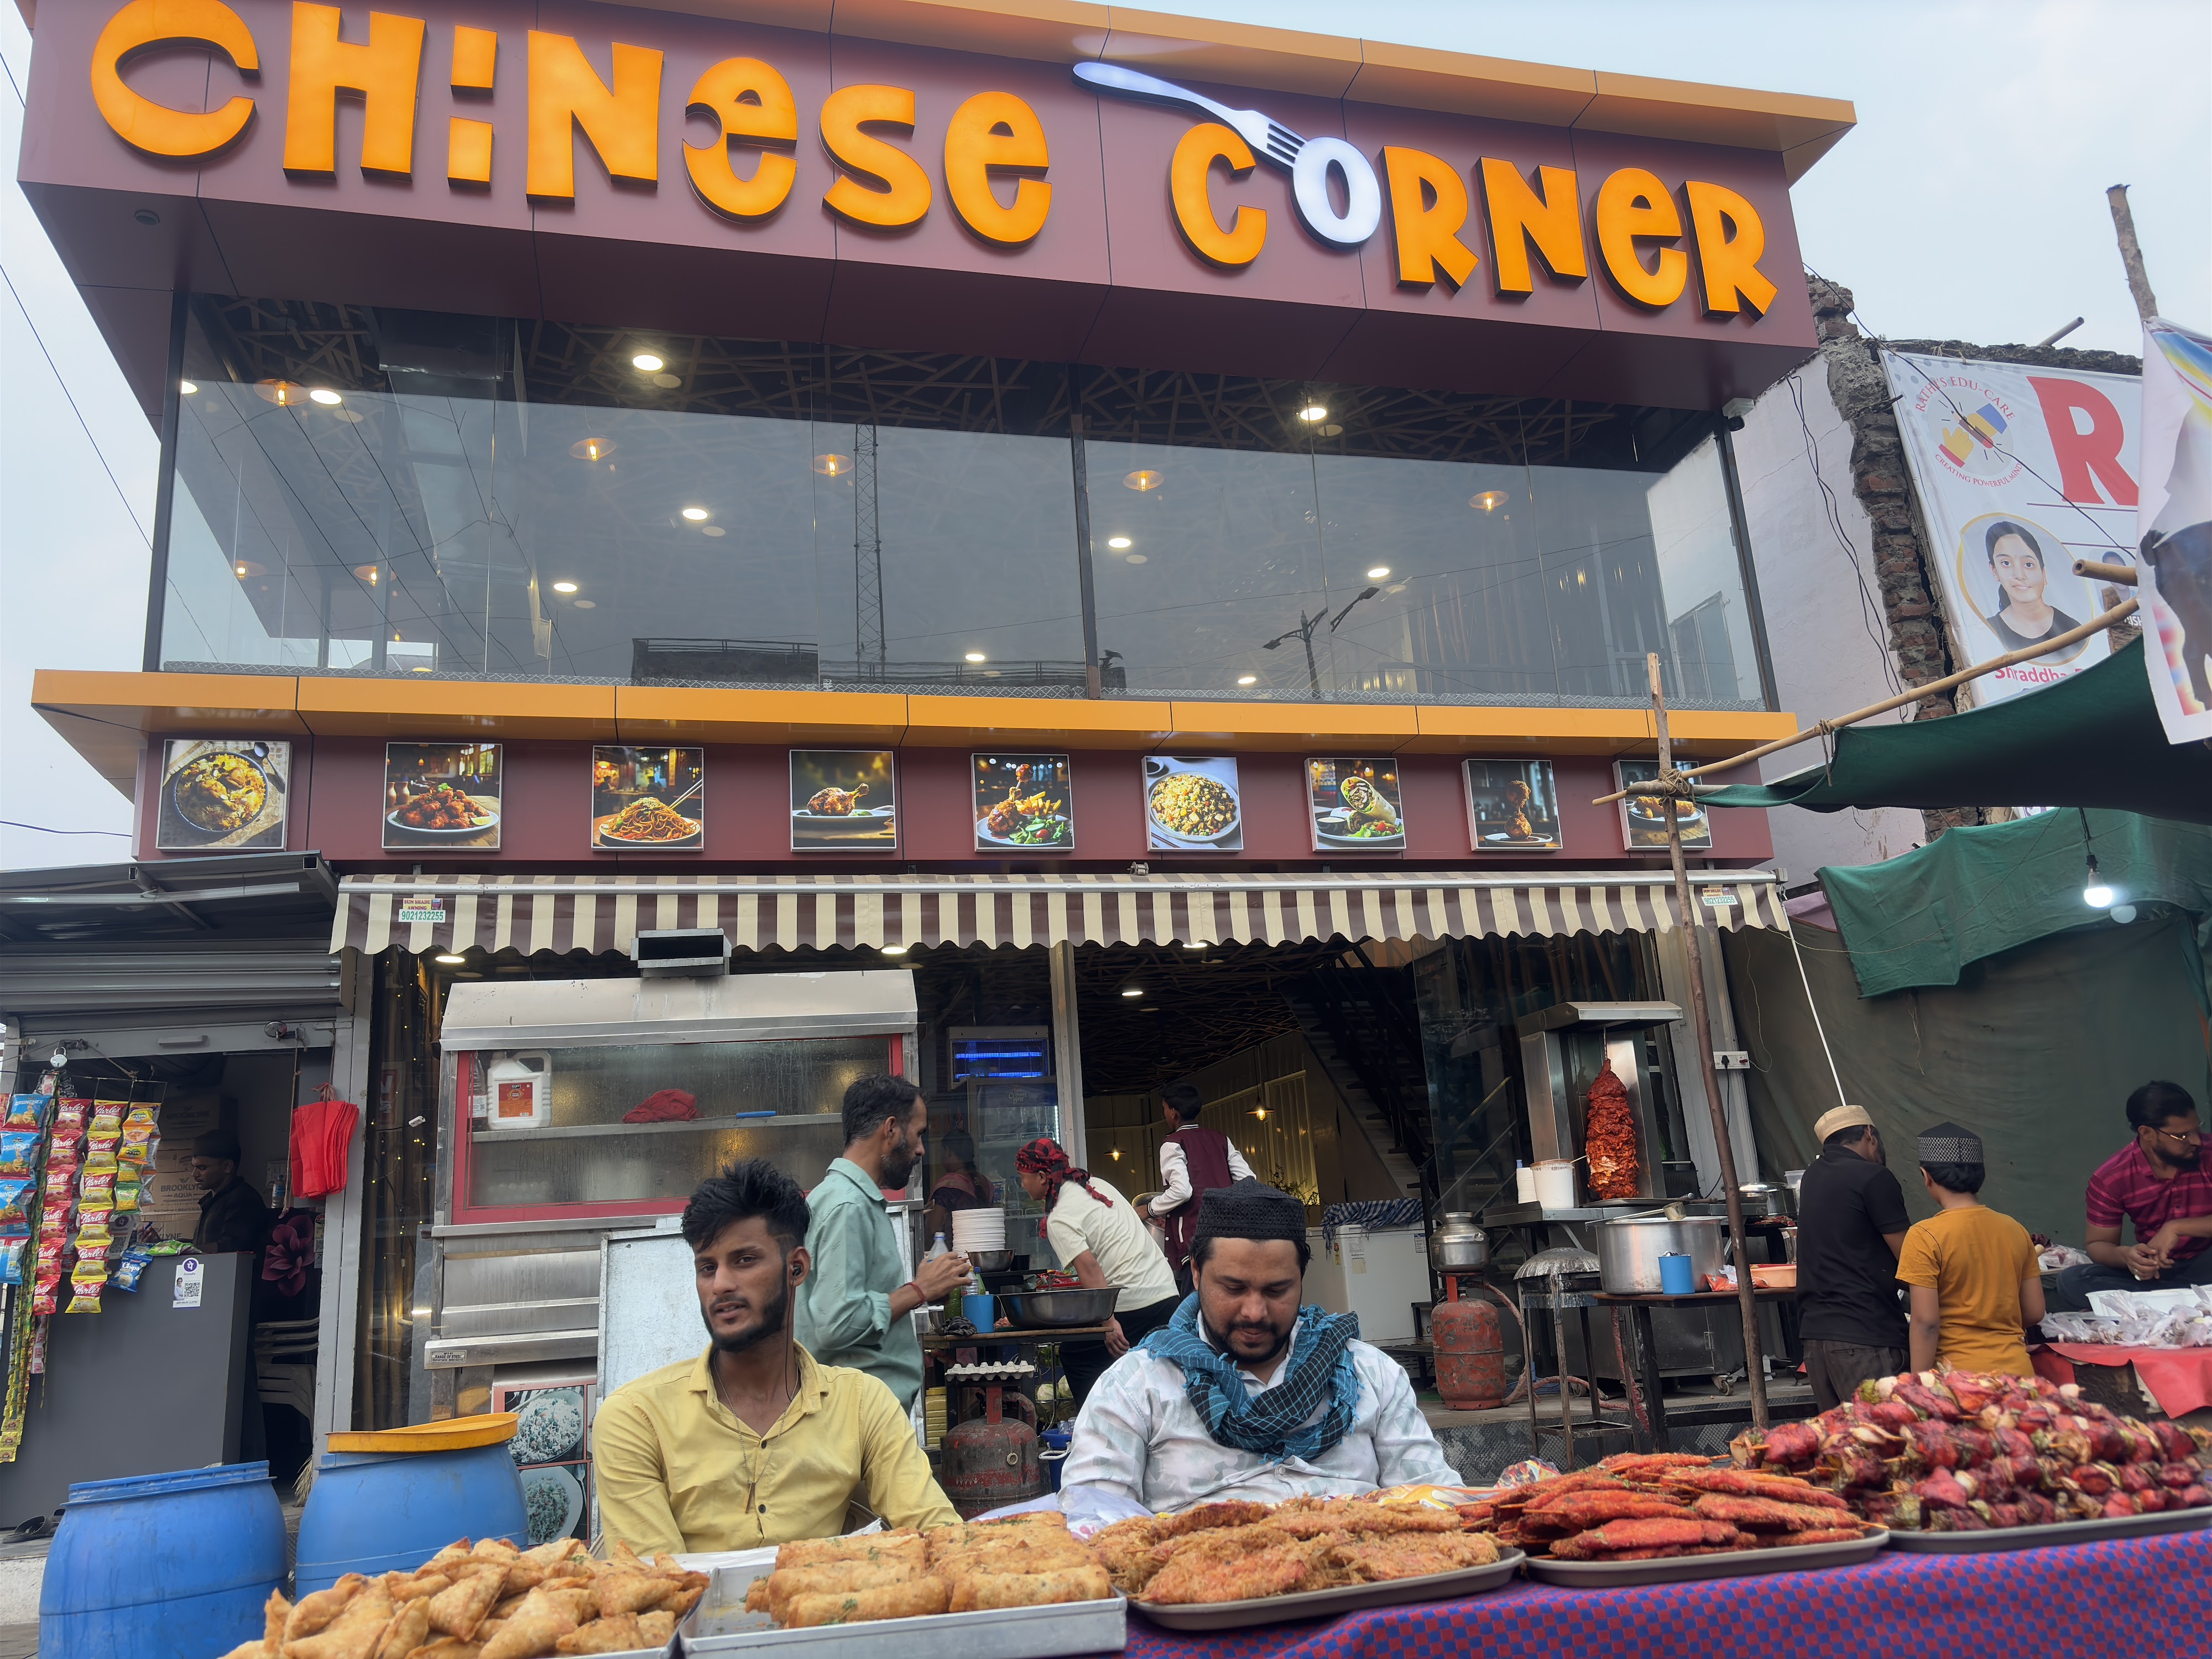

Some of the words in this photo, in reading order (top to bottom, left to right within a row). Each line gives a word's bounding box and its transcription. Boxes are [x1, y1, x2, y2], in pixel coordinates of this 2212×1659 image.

[1949, 376, 2015, 420] EDU-CARE
[1935, 453, 1971, 483] CREATING
[1973, 477, 2010, 487] POWERFUL
[1704, 896, 1735, 905] 9021232255
[401, 911, 444, 921] 9021232255
[59, 1103, 85, 1112] Parle's
[95, 1105, 121, 1115] Parle's
[2, 1143, 31, 1151] CRUNCHEX
[88, 1140, 113, 1151] Parle's
[47, 1173, 69, 1184] Parle's
[85, 1176, 109, 1187] Parle's
[43, 1209, 63, 1220] Parle's
[81, 1212, 107, 1223] Parle's
[38, 1247, 56, 1258] Parle's
[78, 1248, 104, 1259] Parle's
[122, 1262, 140, 1271] Chips
[187, 1261, 194, 1270] पे
[74, 1285, 100, 1295] Parle's
